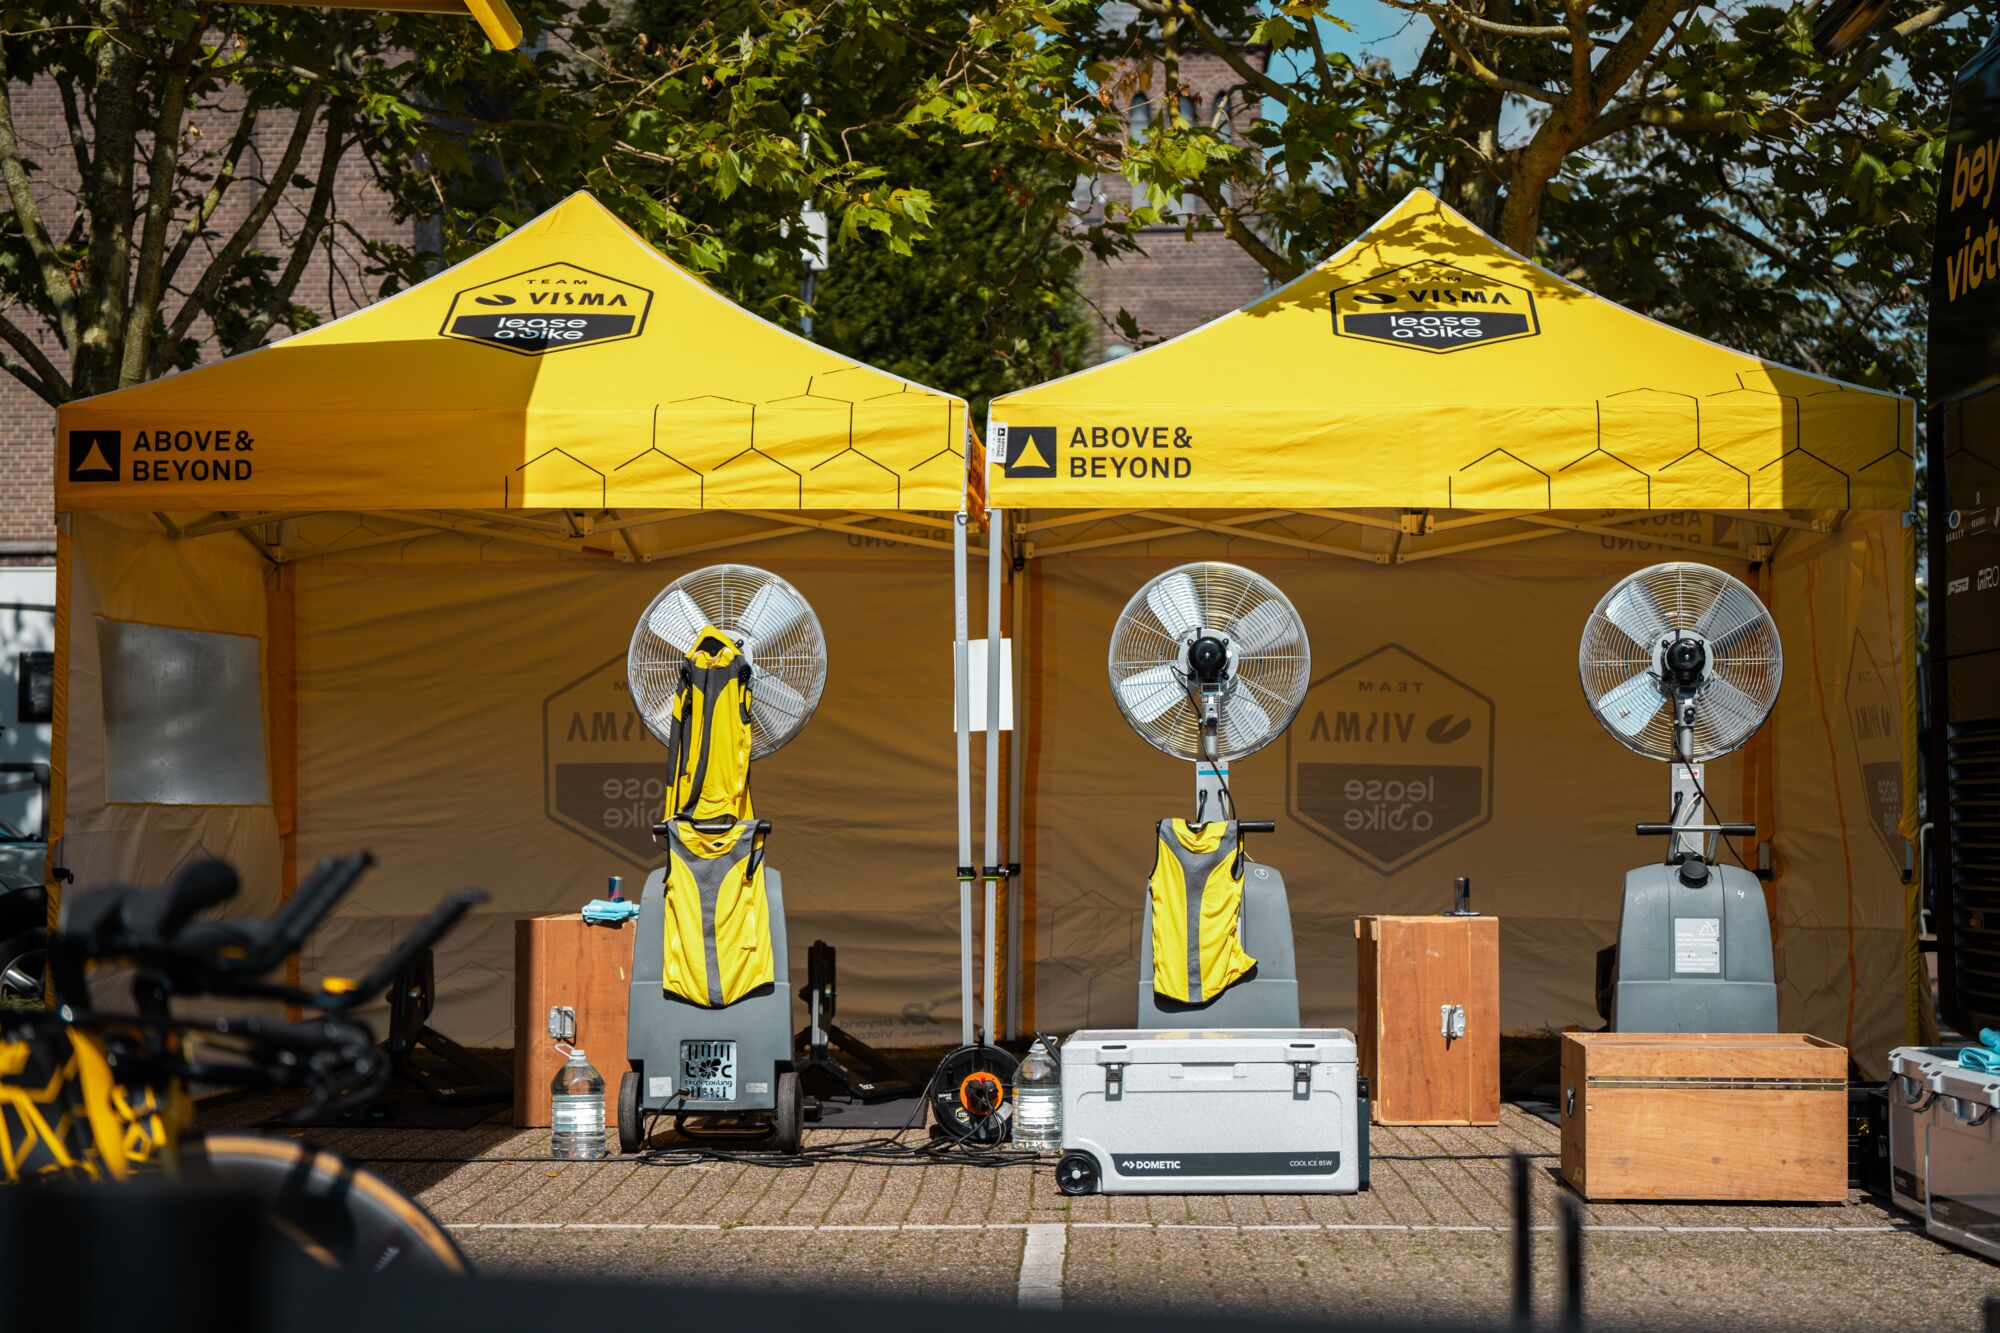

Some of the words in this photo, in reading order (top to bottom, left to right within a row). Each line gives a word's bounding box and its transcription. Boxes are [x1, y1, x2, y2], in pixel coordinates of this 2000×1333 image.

[529, 292, 628, 307] VISMA
[1407, 289, 1512, 305] VISMA
[498, 317, 587, 329] lease
[1390, 315, 1481, 327] lease
[133, 460, 253, 481] BEYOND
[1069, 456, 1192, 479] BEYOND
[1977, 565, 2000, 592] GIRO
[1737, 890, 1745, 899] 4
[1136, 1160, 1181, 1170] DOMETIC
